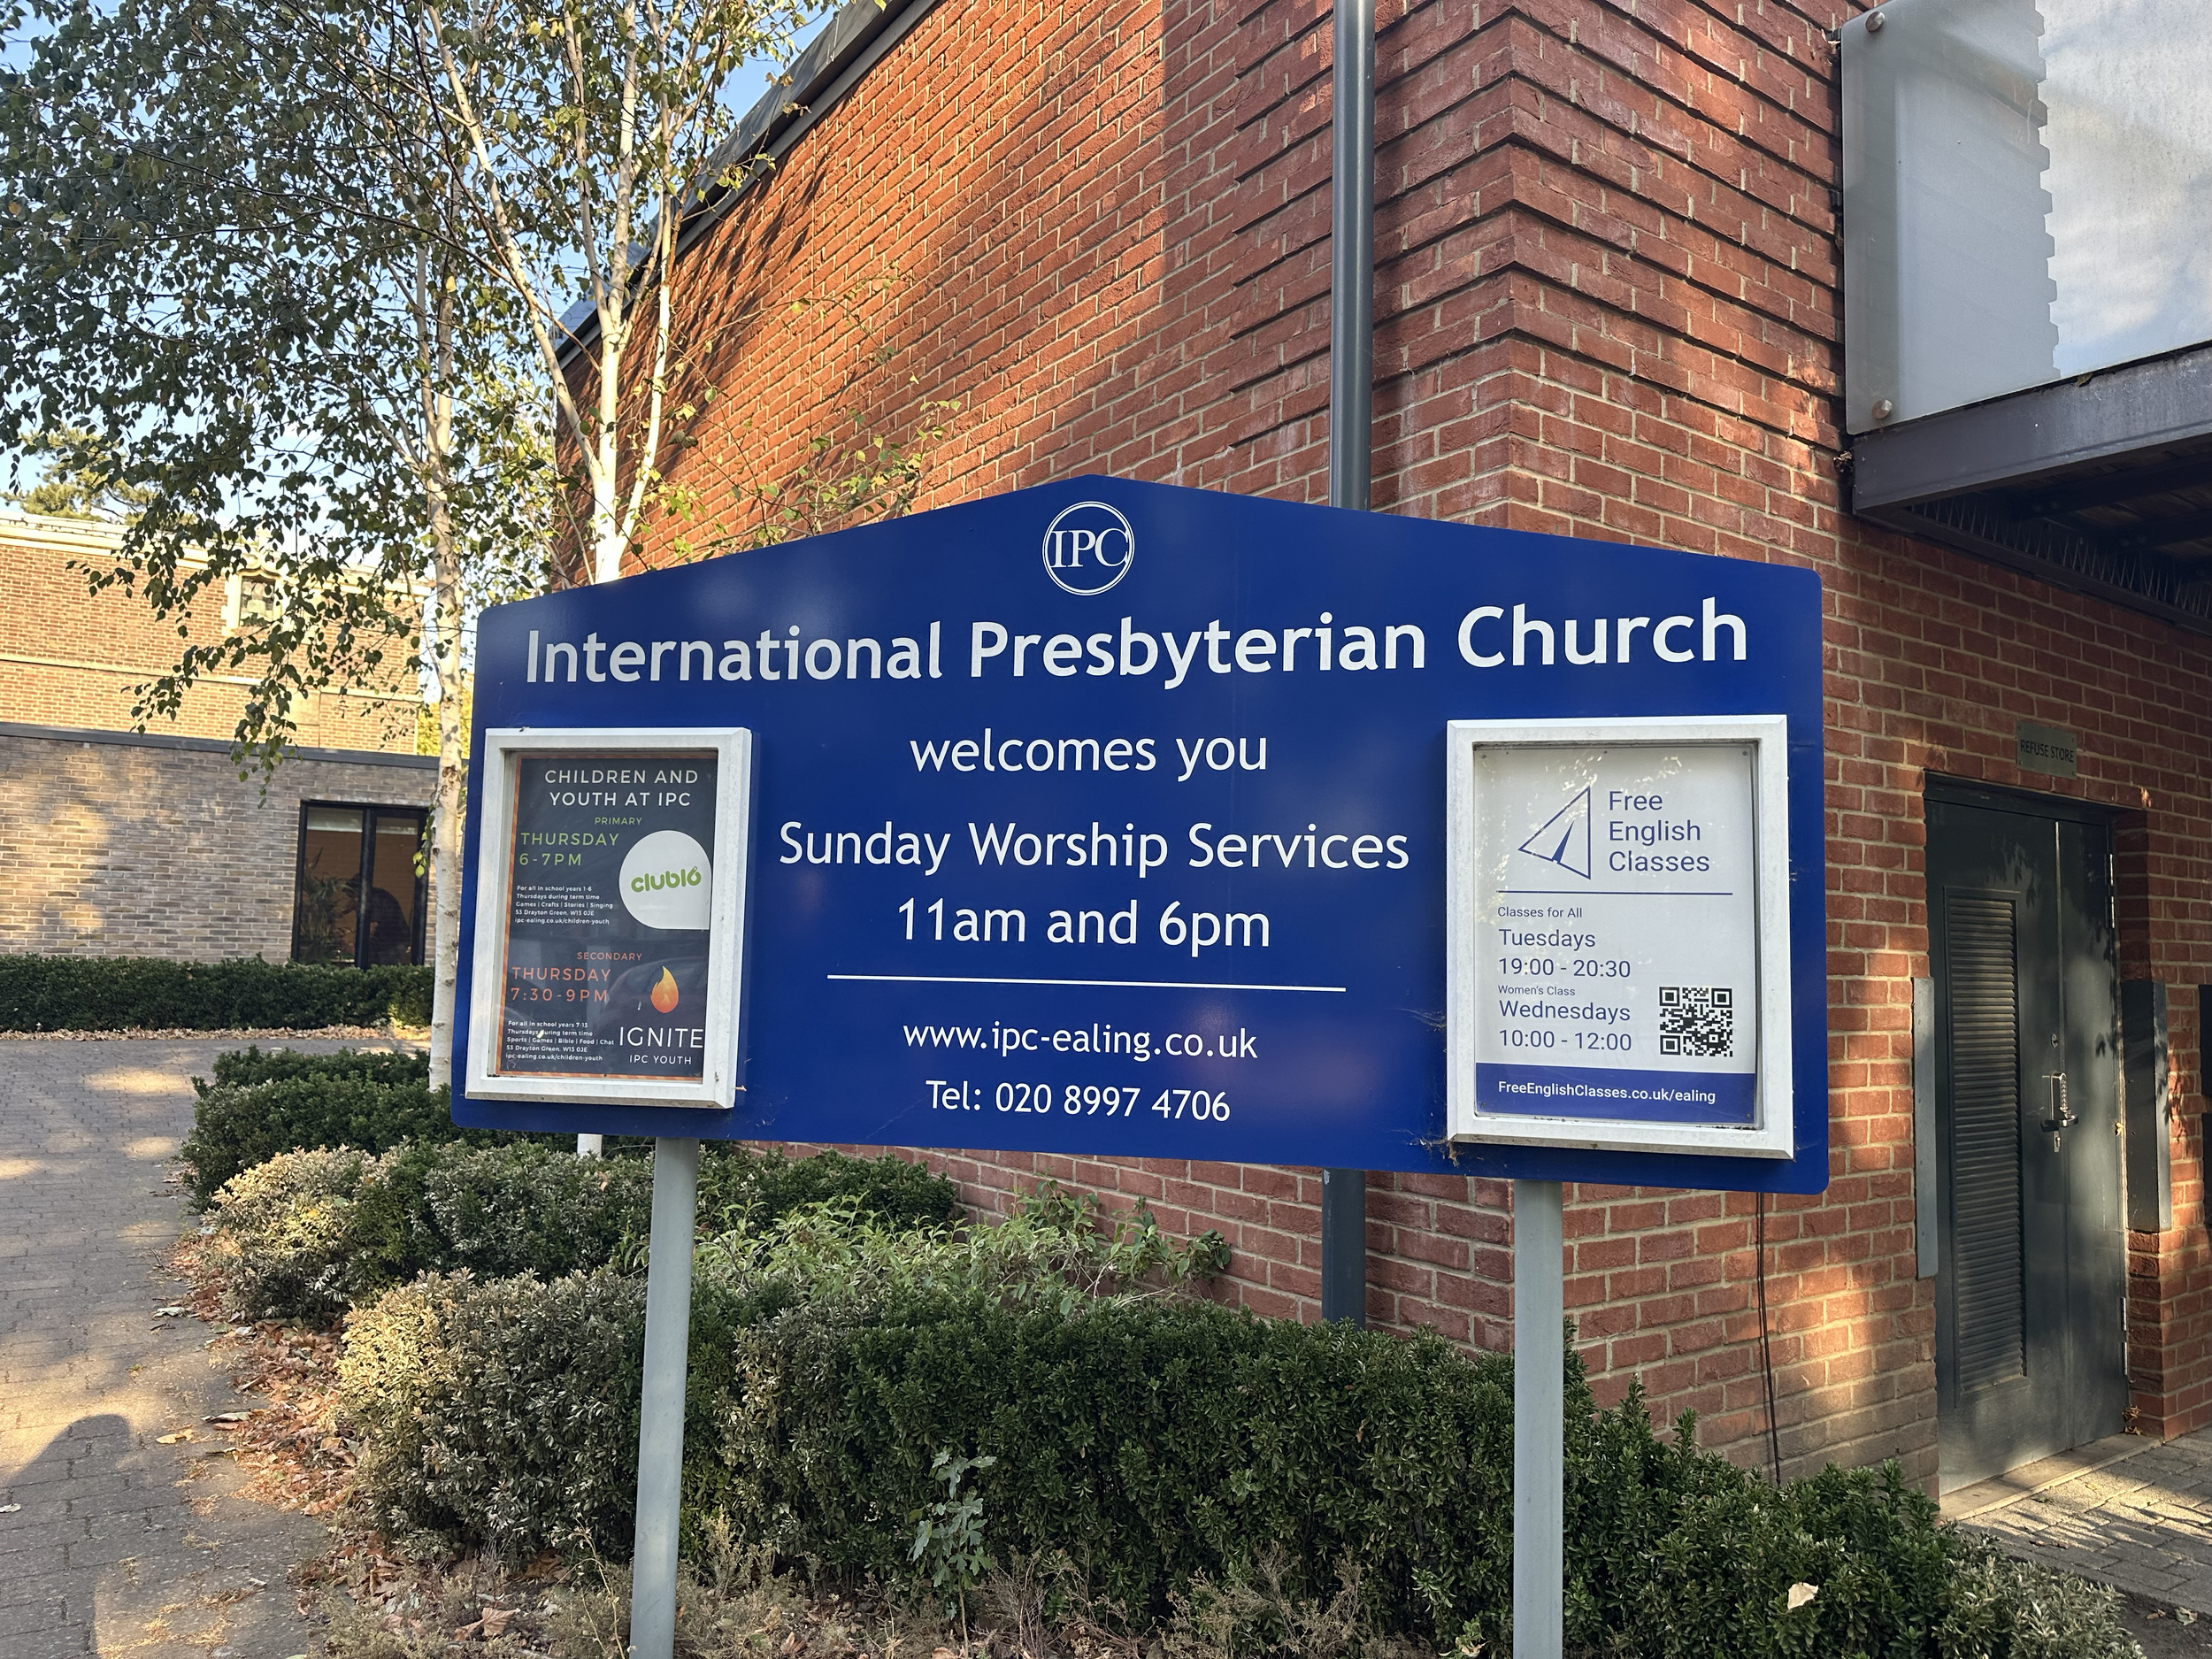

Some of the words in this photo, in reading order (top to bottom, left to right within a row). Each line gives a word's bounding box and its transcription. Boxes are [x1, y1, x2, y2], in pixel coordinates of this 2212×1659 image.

[1050, 527, 1129, 568] IPC
[525, 621, 941, 683] International
[972, 613, 1425, 689] Presbyterian
[1458, 597, 1746, 668] Church
[910, 728, 1156, 772] welcomes
[1176, 738, 1267, 781] you
[2020, 740, 2049, 757] REFUSE
[2050, 746, 2074, 763] STORE
[545, 770, 646, 784] CHILDREN
[654, 770, 698, 784] AND
[549, 793, 616, 806] YOUTH
[625, 793, 649, 806] AT
[658, 793, 691, 806] IPC
[1609, 791, 1663, 811] Free
[520, 833, 619, 846] THURSDAY
[1609, 820, 1701, 847] English
[780, 820, 950, 875] Sunday
[969, 822, 1168, 879] Worship
[1189, 823, 1409, 870] Services
[1609, 850, 1710, 872] Classes
[1497, 907, 1544, 918] Classes
[1547, 906, 1565, 918] for
[1567, 907, 1583, 918] All
[899, 898, 1025, 942] 11am
[1048, 900, 1138, 945] and
[1160, 901, 1270, 957] 6pm
[1499, 928, 1596, 950] Tuesdays
[577, 952, 642, 961] SECONDARY
[512, 967, 611, 981] THURSDAY
[1499, 958, 1555, 977] 19:00
[1573, 958, 1632, 978] 20:30
[1547, 986, 1576, 997] Class
[1499, 1000, 1631, 1025] Wednesdays
[620, 1026, 704, 1049] IGNITE
[902, 1021, 1258, 1063] www.ipc-ealing.co.uk
[1499, 1029, 1555, 1048] 10:00
[1574, 1032, 1632, 1051] 12:00
[629, 1055, 649, 1064] IPC
[653, 1056, 692, 1065] YOUTH
[926, 1080, 981, 1111] Tel:
[996, 1083, 1052, 1114] 020
[1064, 1086, 1141, 1117] 8997
[1152, 1089, 1231, 1122] 4706
[1498, 1079, 1717, 1104] FreeEnglishClasses.co.uk/ealing
